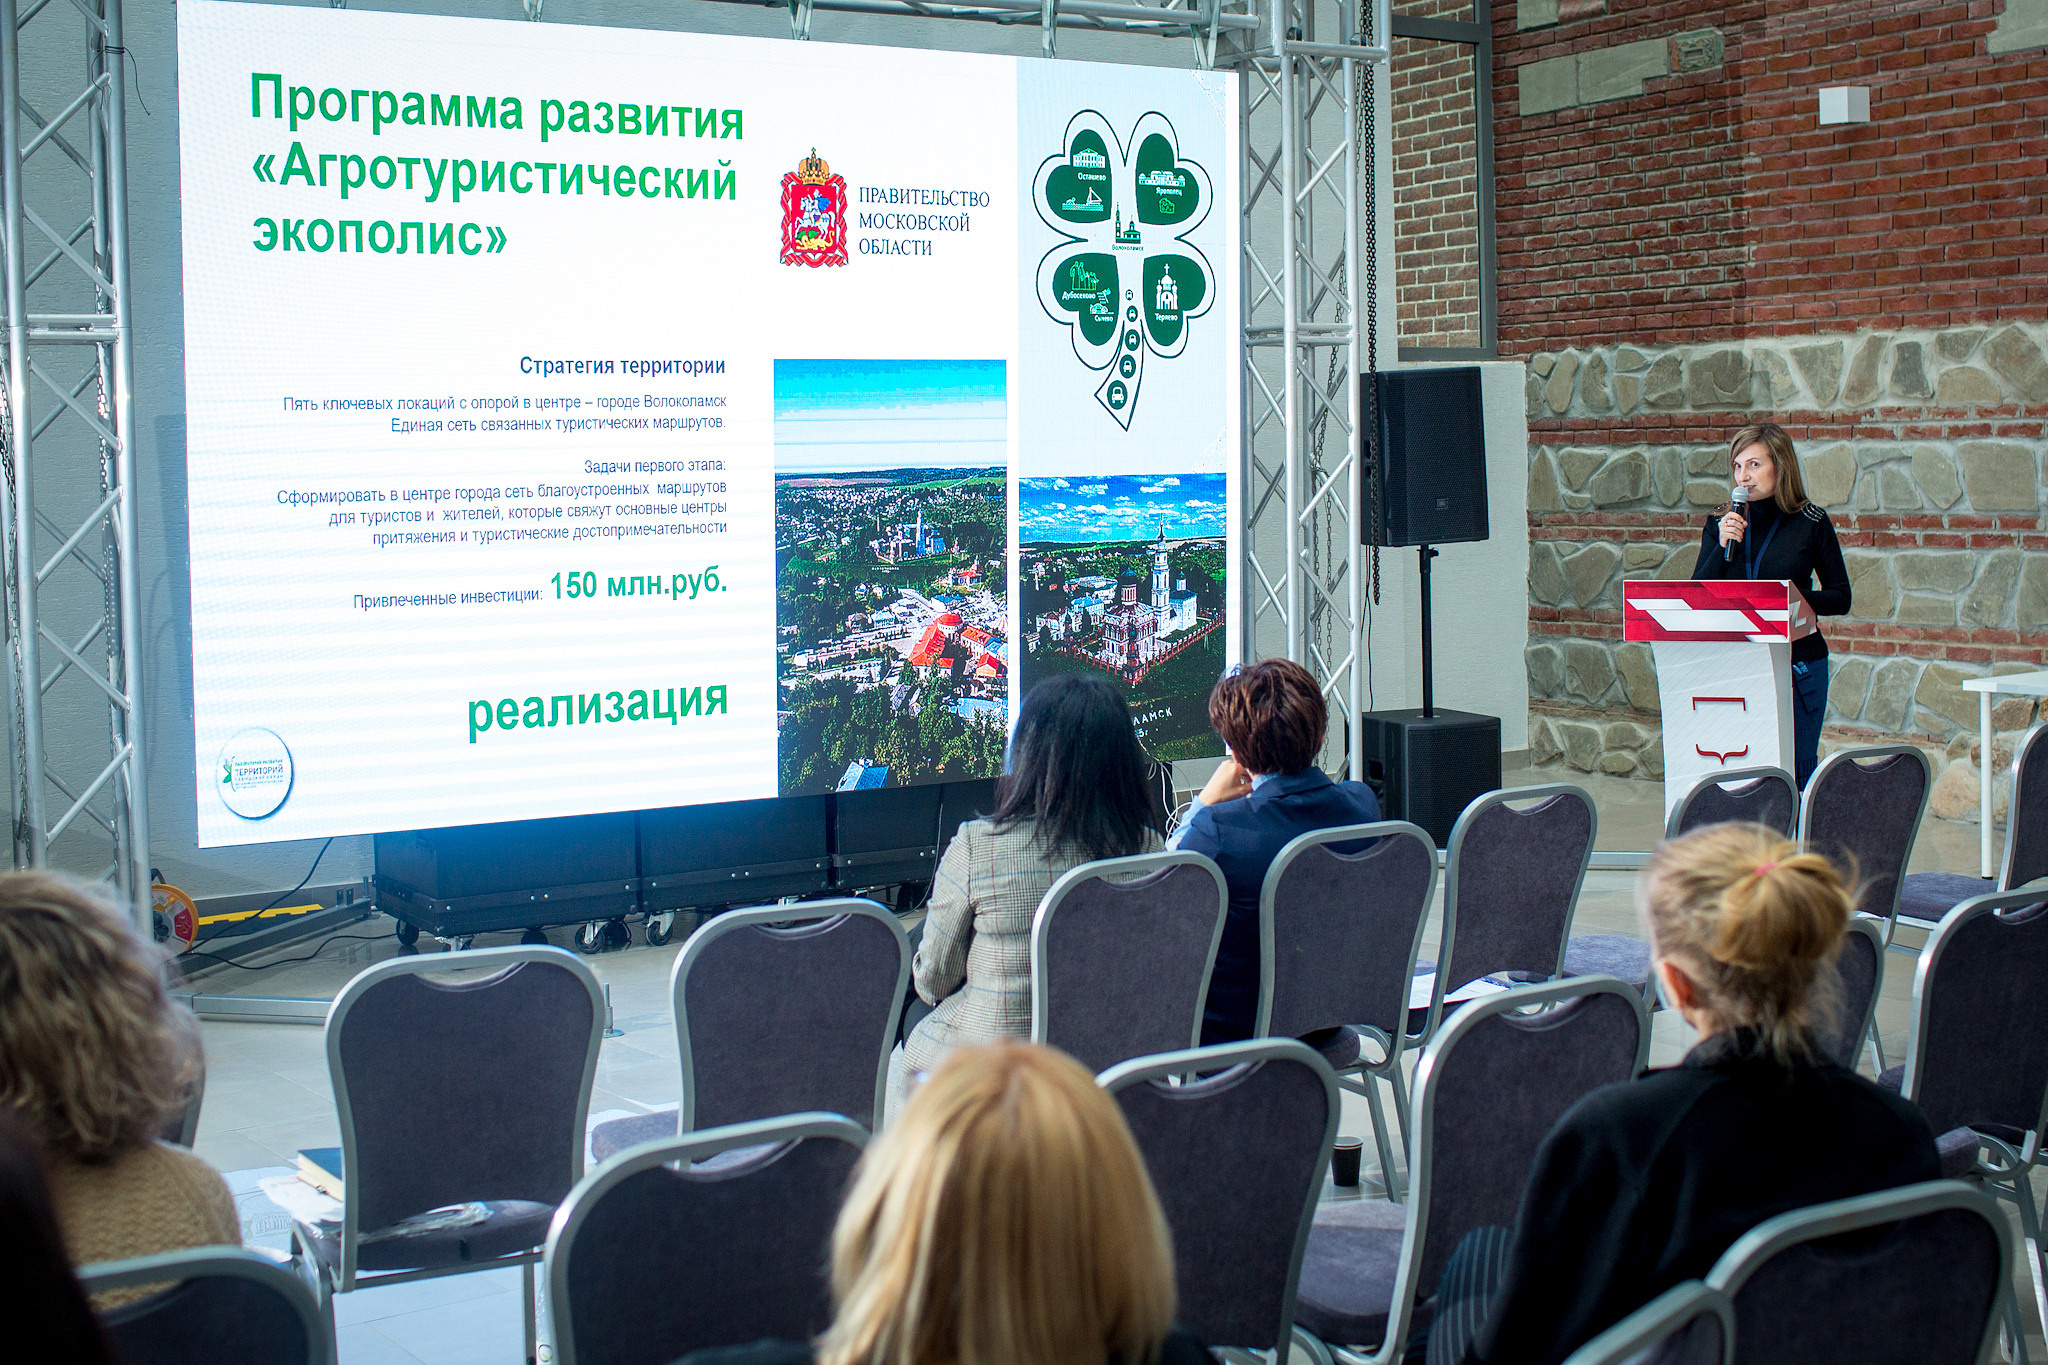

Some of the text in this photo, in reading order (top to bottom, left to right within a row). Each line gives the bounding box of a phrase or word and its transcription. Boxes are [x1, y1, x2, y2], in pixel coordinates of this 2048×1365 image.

[251, 72, 743, 142] Программа развития
[252, 141, 737, 203] «Агротуристический
[859, 186, 990, 207] ПРАВИТЕЛЬСТВО
[859, 212, 970, 231] МОСКОВСКОЙ
[253, 216, 508, 255] экополис»
[859, 238, 932, 256] ОБЛАСТИ
[520, 356, 725, 377] Стратегия территории
[283, 397, 319, 411] Пять
[323, 399, 393, 411] ключевых
[397, 396, 455, 412] локаций
[460, 399, 467, 409] с
[471, 395, 519, 412] опорой
[524, 398, 531, 409] в
[535, 397, 581, 412] центре
[597, 397, 640, 411] городе
[644, 394, 727, 408] Волоколамск
[391, 416, 726, 434] Единая сеть связанных туристических маршрутов.
[585, 460, 726, 475] Задачи первого этапа:
[277, 481, 727, 507] Сформировать в центре города сеть благоустроенных маршрутов
[329, 501, 727, 526] для туристов и жителей, которые свяжут основные центры
[373, 521, 727, 548] притяжения и туристические достопримечательности
[354, 565, 727, 611] Привлеченные инвестиции: 150 млн.руб.
[468, 685, 728, 744] реализация
[235, 764, 283, 776] ТЕРРИТОРИЙ
